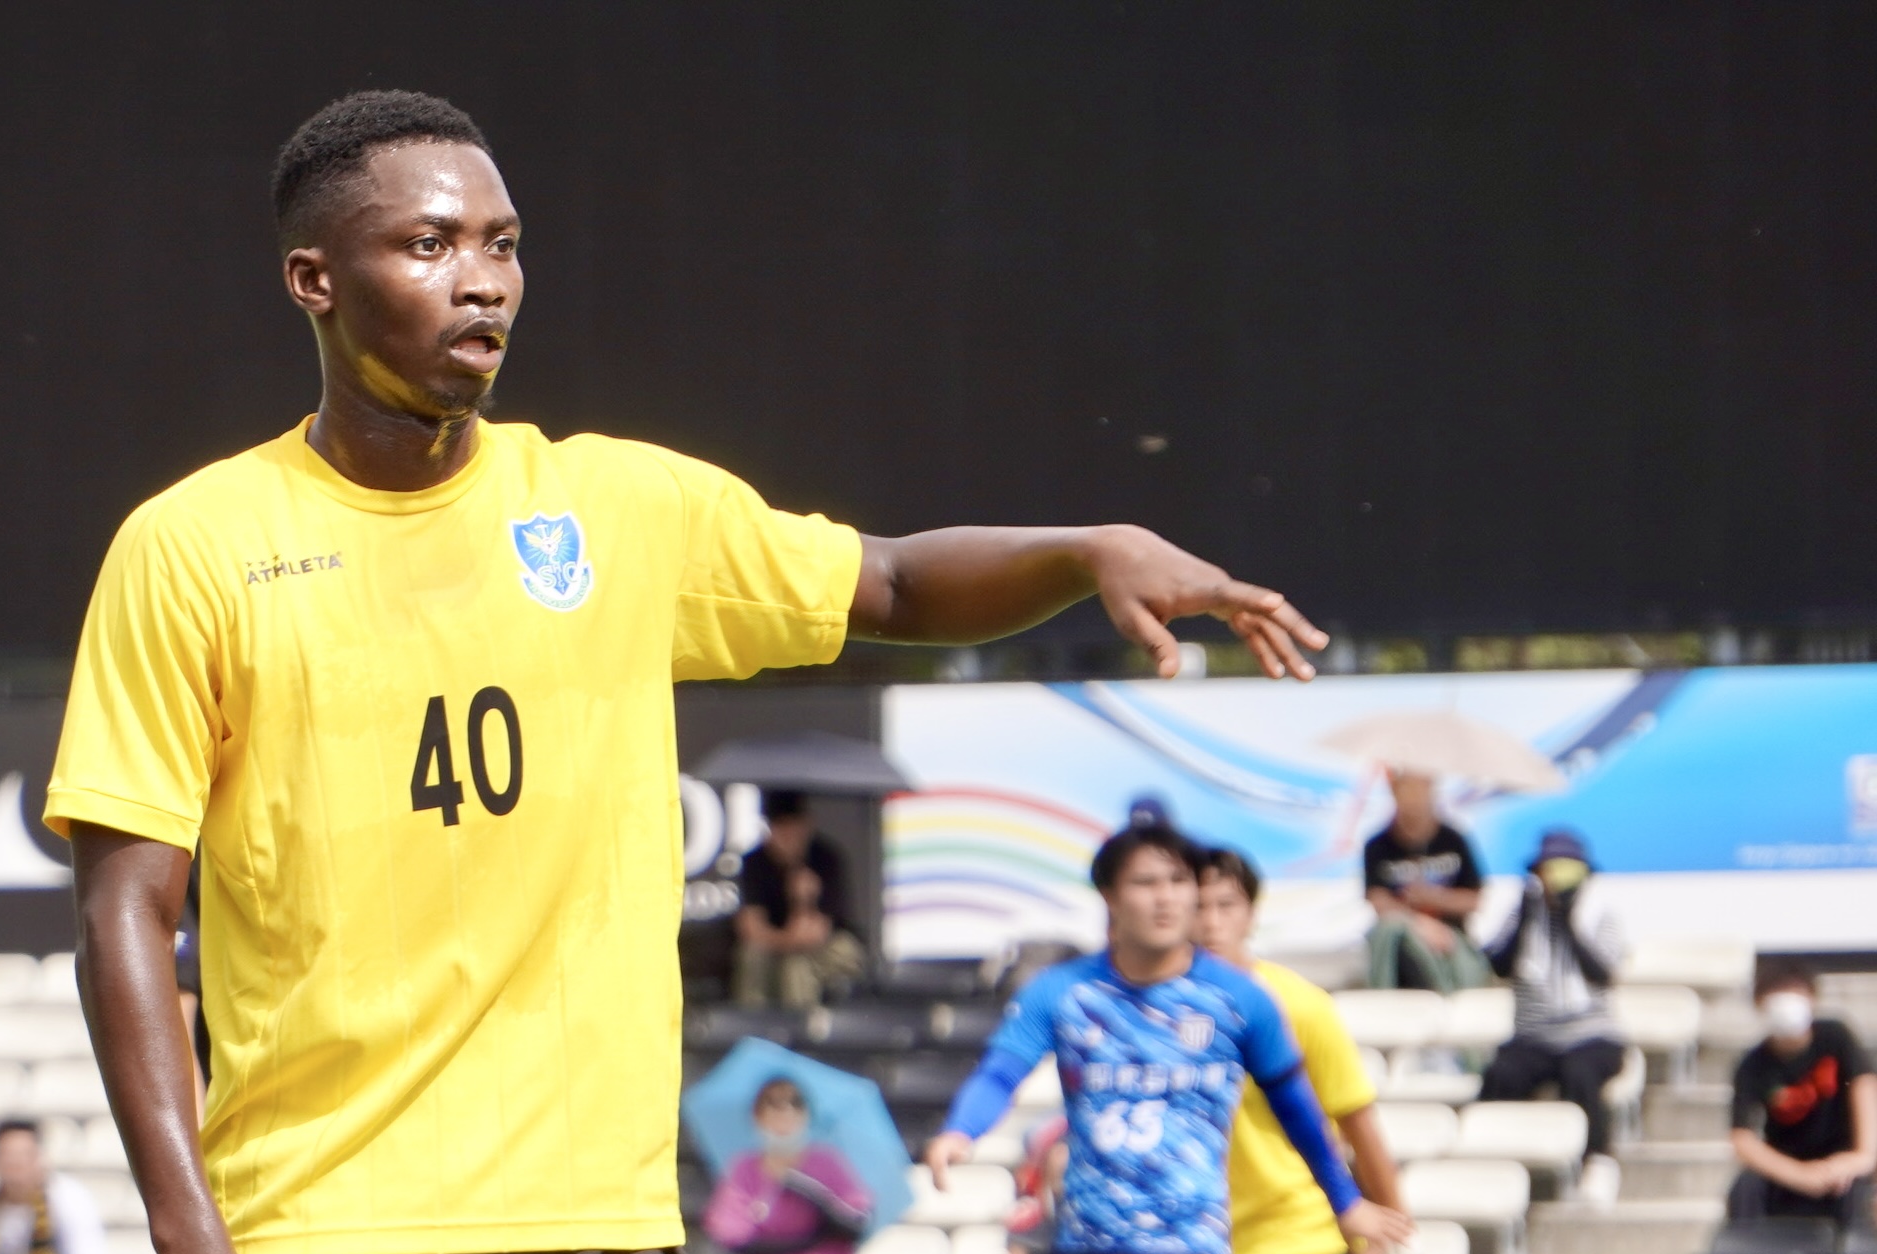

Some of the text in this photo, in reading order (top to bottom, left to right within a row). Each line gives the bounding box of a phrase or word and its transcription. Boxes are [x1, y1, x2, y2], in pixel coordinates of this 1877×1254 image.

[247, 553, 343, 585] ATHLETA
[410, 685, 524, 828] 40
[1092, 1099, 1168, 1152] 65
